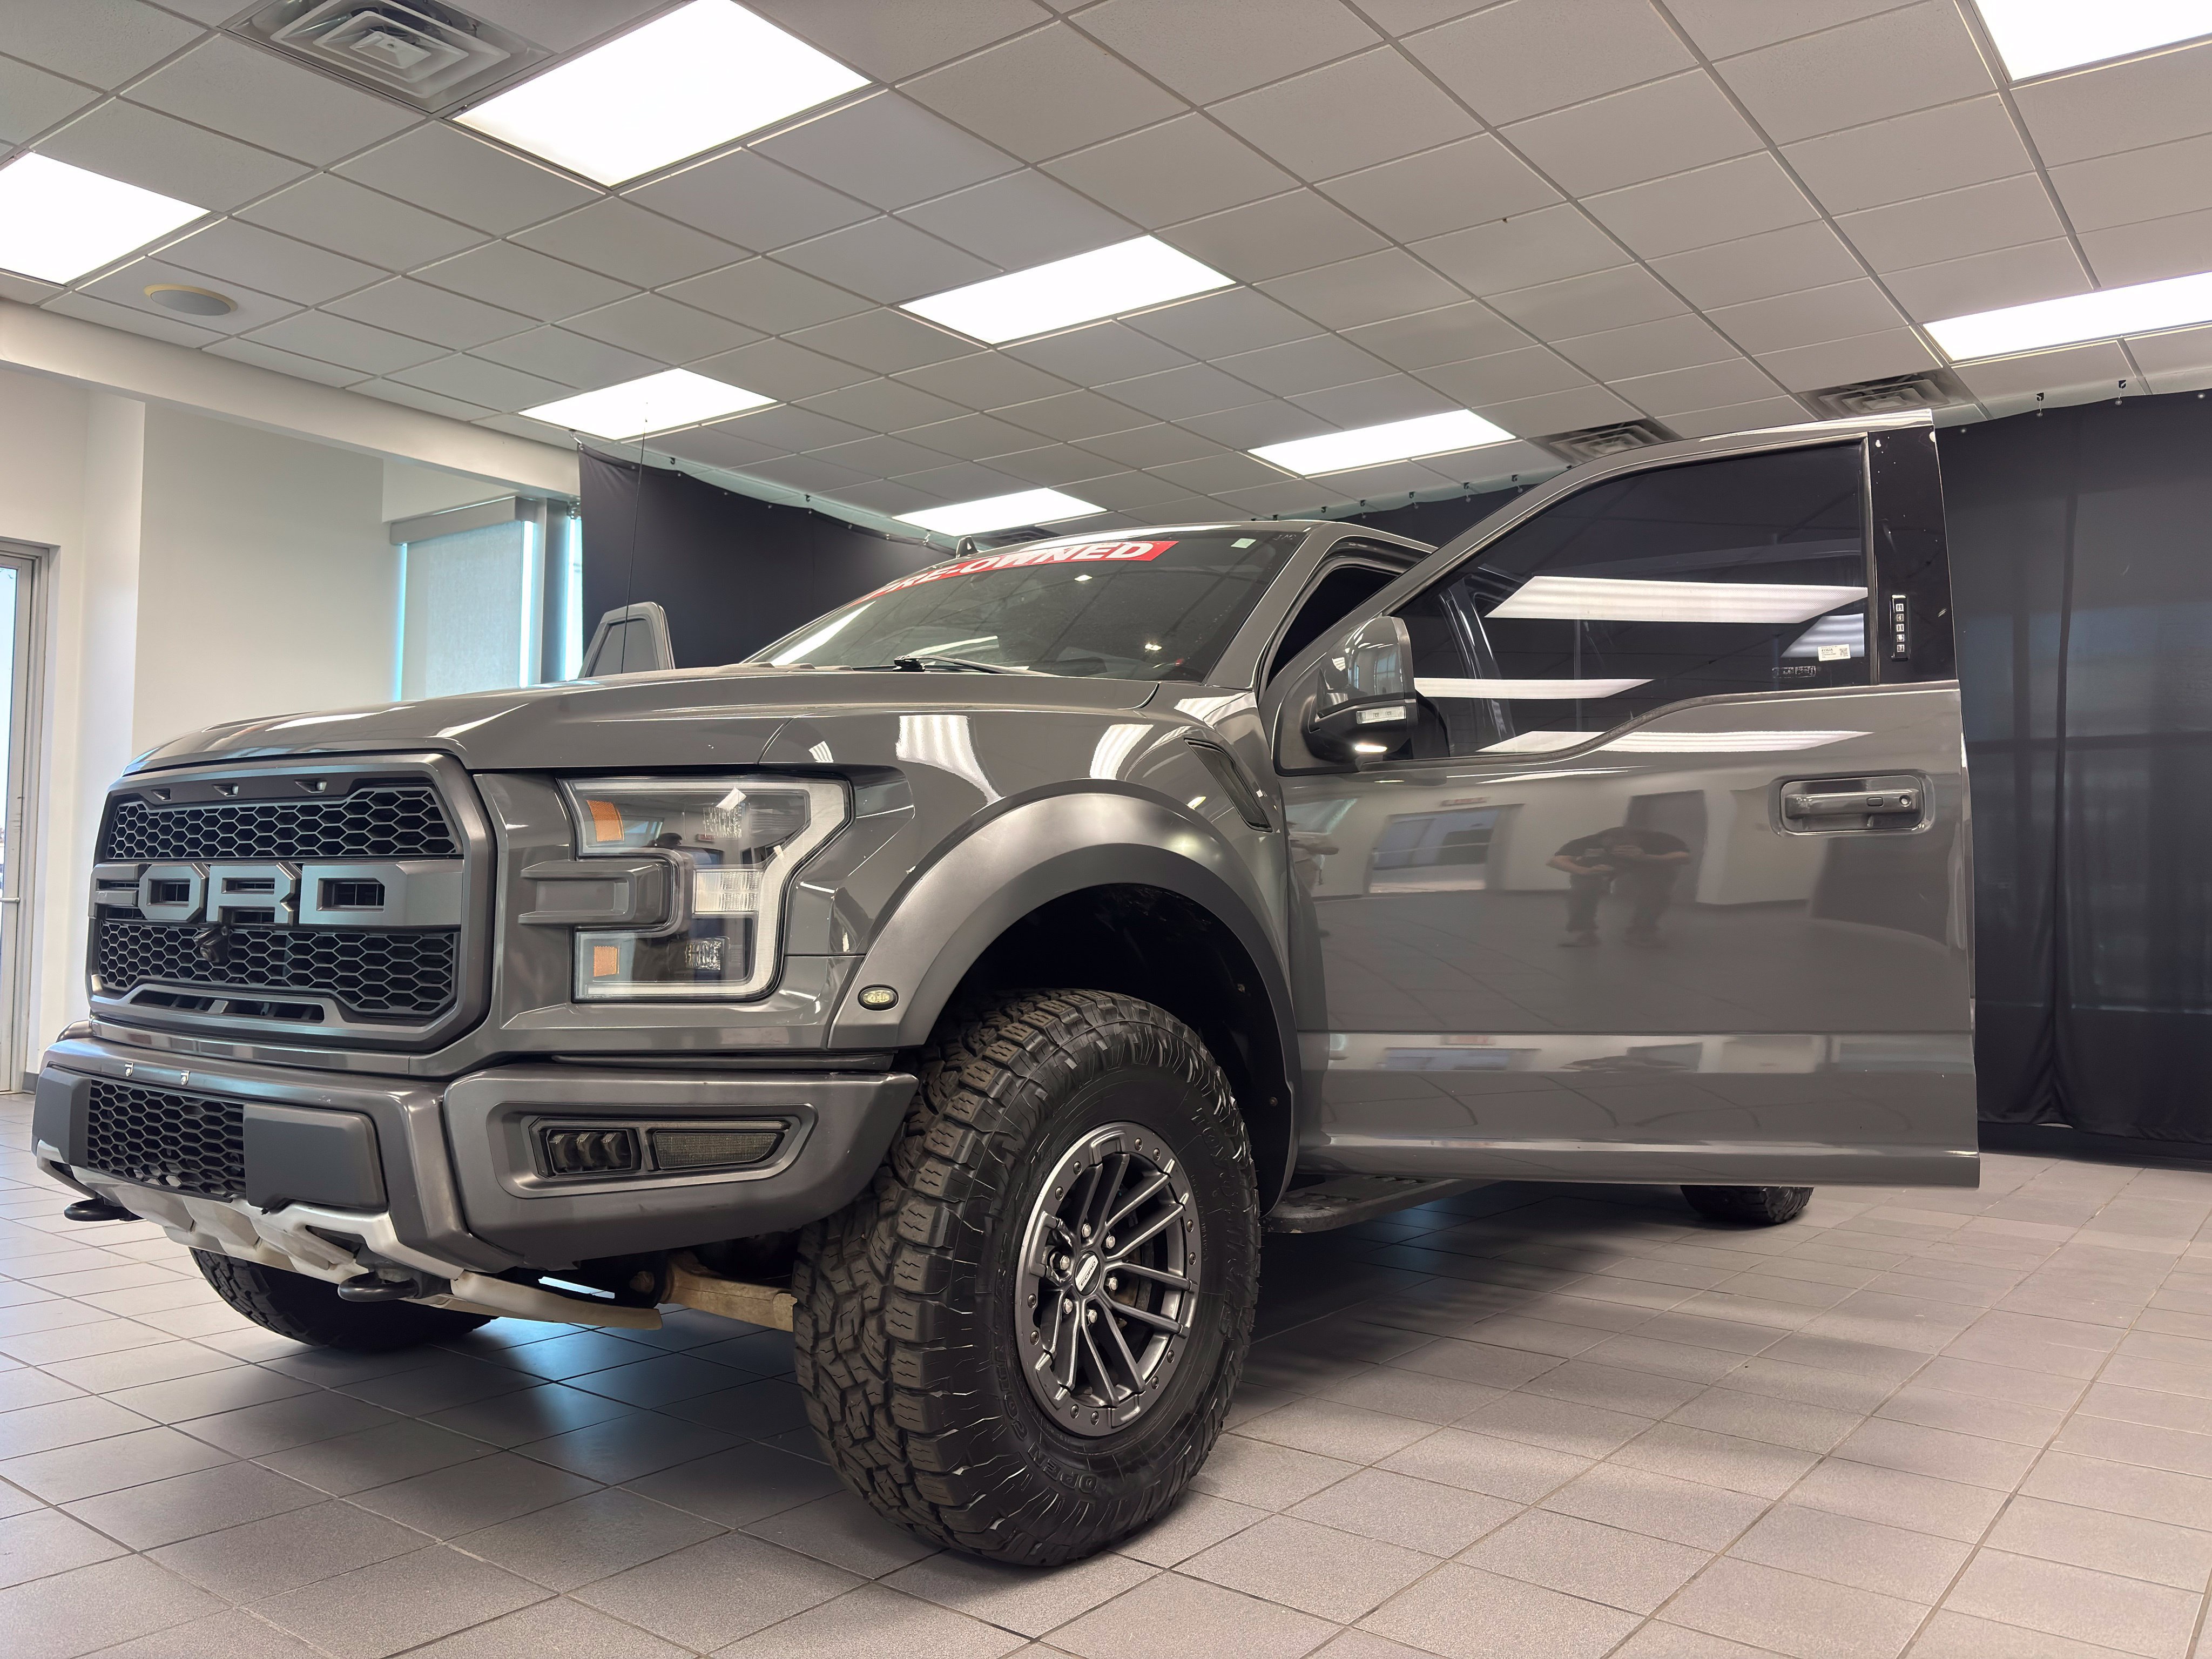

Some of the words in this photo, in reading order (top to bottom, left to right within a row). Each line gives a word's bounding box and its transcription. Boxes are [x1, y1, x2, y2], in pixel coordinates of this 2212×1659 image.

[861, 541, 1154, 602] PRE-OWNED
[88, 860, 410, 927] FORD
[1081, 1260, 1096, 1286] FORD
[1027, 1442, 1098, 1494] OPEN
